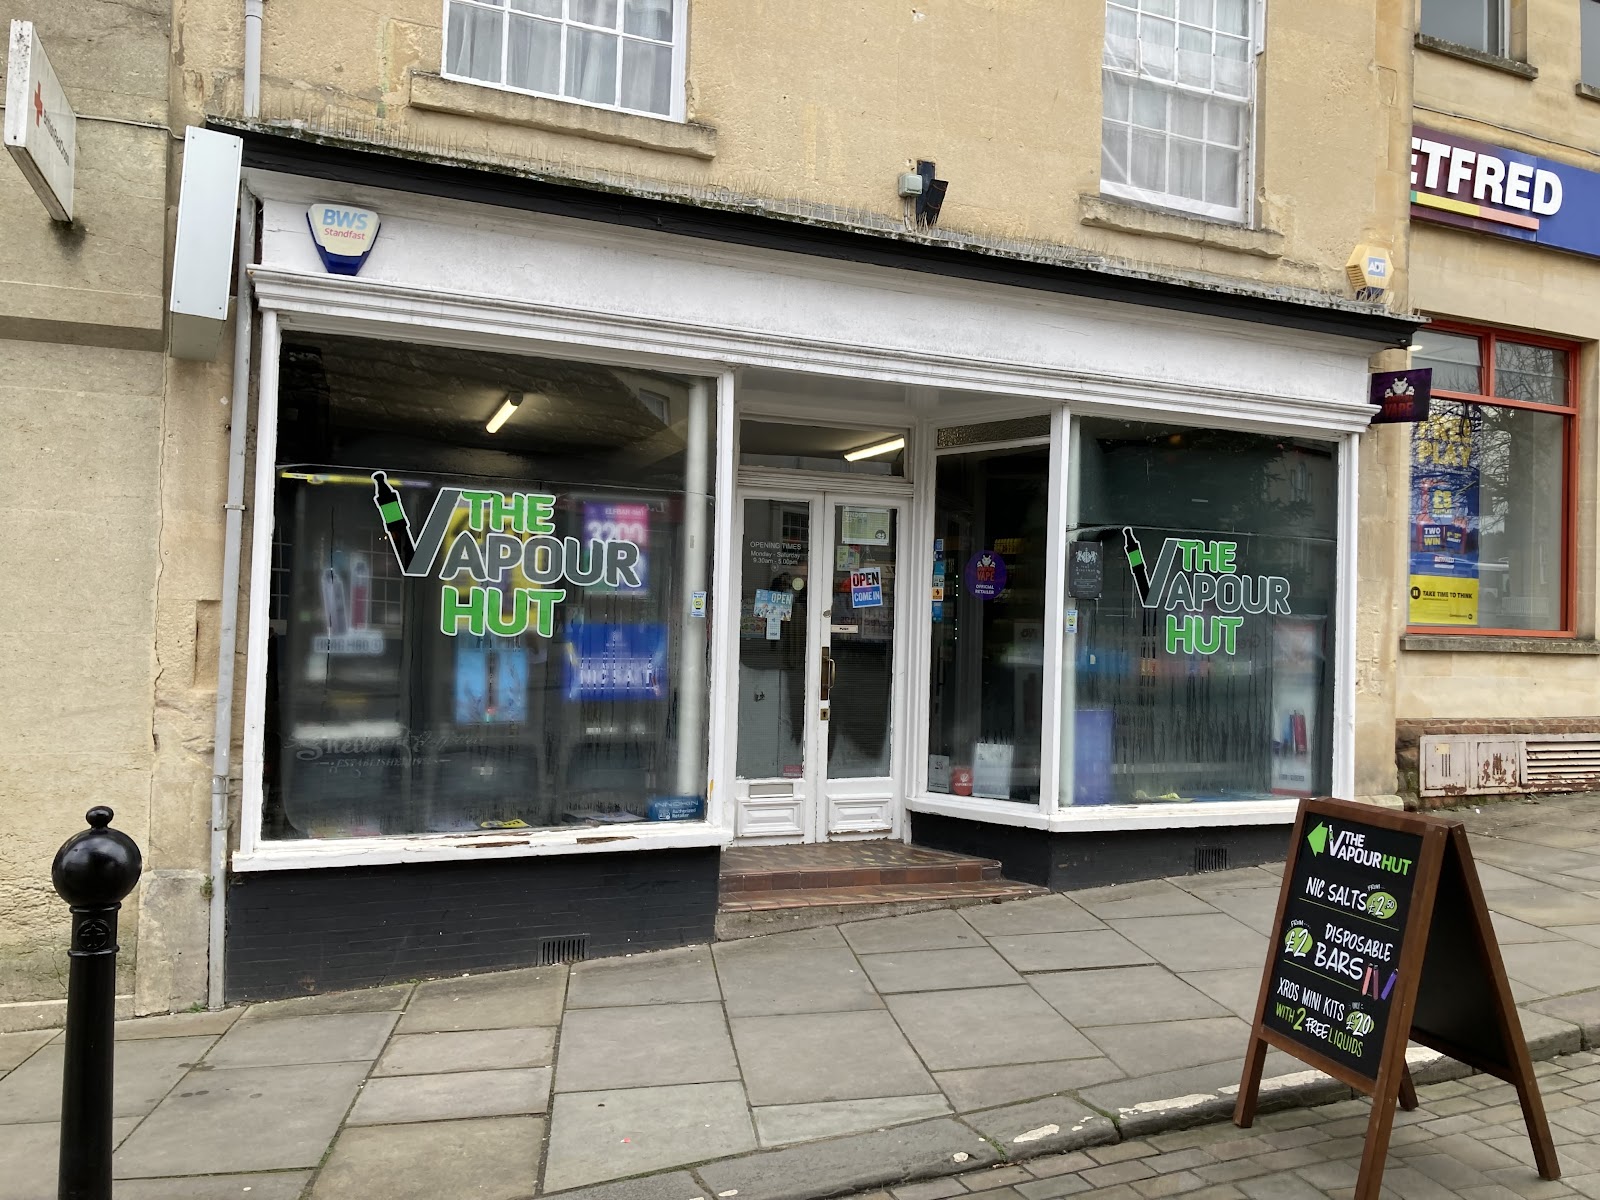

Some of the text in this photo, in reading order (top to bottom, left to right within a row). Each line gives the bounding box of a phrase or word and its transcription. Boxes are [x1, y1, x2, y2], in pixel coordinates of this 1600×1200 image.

[322, 209, 368, 231] BWS
[324, 227, 366, 241] Standfast
[1368, 262, 1385, 274] ADT
[1418, 440, 1473, 468] PLAY
[461, 490, 556, 534] THE
[371, 471, 641, 587] VAPOUR
[1424, 527, 1441, 535] TWO
[1424, 537, 1441, 546] WIN
[750, 541, 802, 550] OPENING TIMES
[750, 550, 773, 558] Monday
[777, 551, 801, 560] Saturday
[1177, 539, 1237, 573] THE
[853, 571, 880, 587] OPEN
[977, 571, 995, 582] VAPE
[1123, 526, 1291, 614] VAPOUR
[771, 592, 792, 605] OPEN
[854, 590, 880, 602] COME IN
[440, 585, 566, 638] HUT
[1166, 614, 1244, 655] HUT
[1329, 824, 1413, 876] VAPOUR HUT
[1345, 831, 1365, 847] THE
[1305, 876, 1367, 911] NIC SALTS
[1284, 928, 1309, 958] £2
[1324, 922, 1394, 962] DISPOSABLE
[1314, 941, 1364, 981] BARS
[1276, 976, 1345, 1022] XROS MINI KITS
[1275, 1002, 1364, 1058] WITH 2 FREE LIQUIDS
[1345, 1012, 1372, 1037] £20
